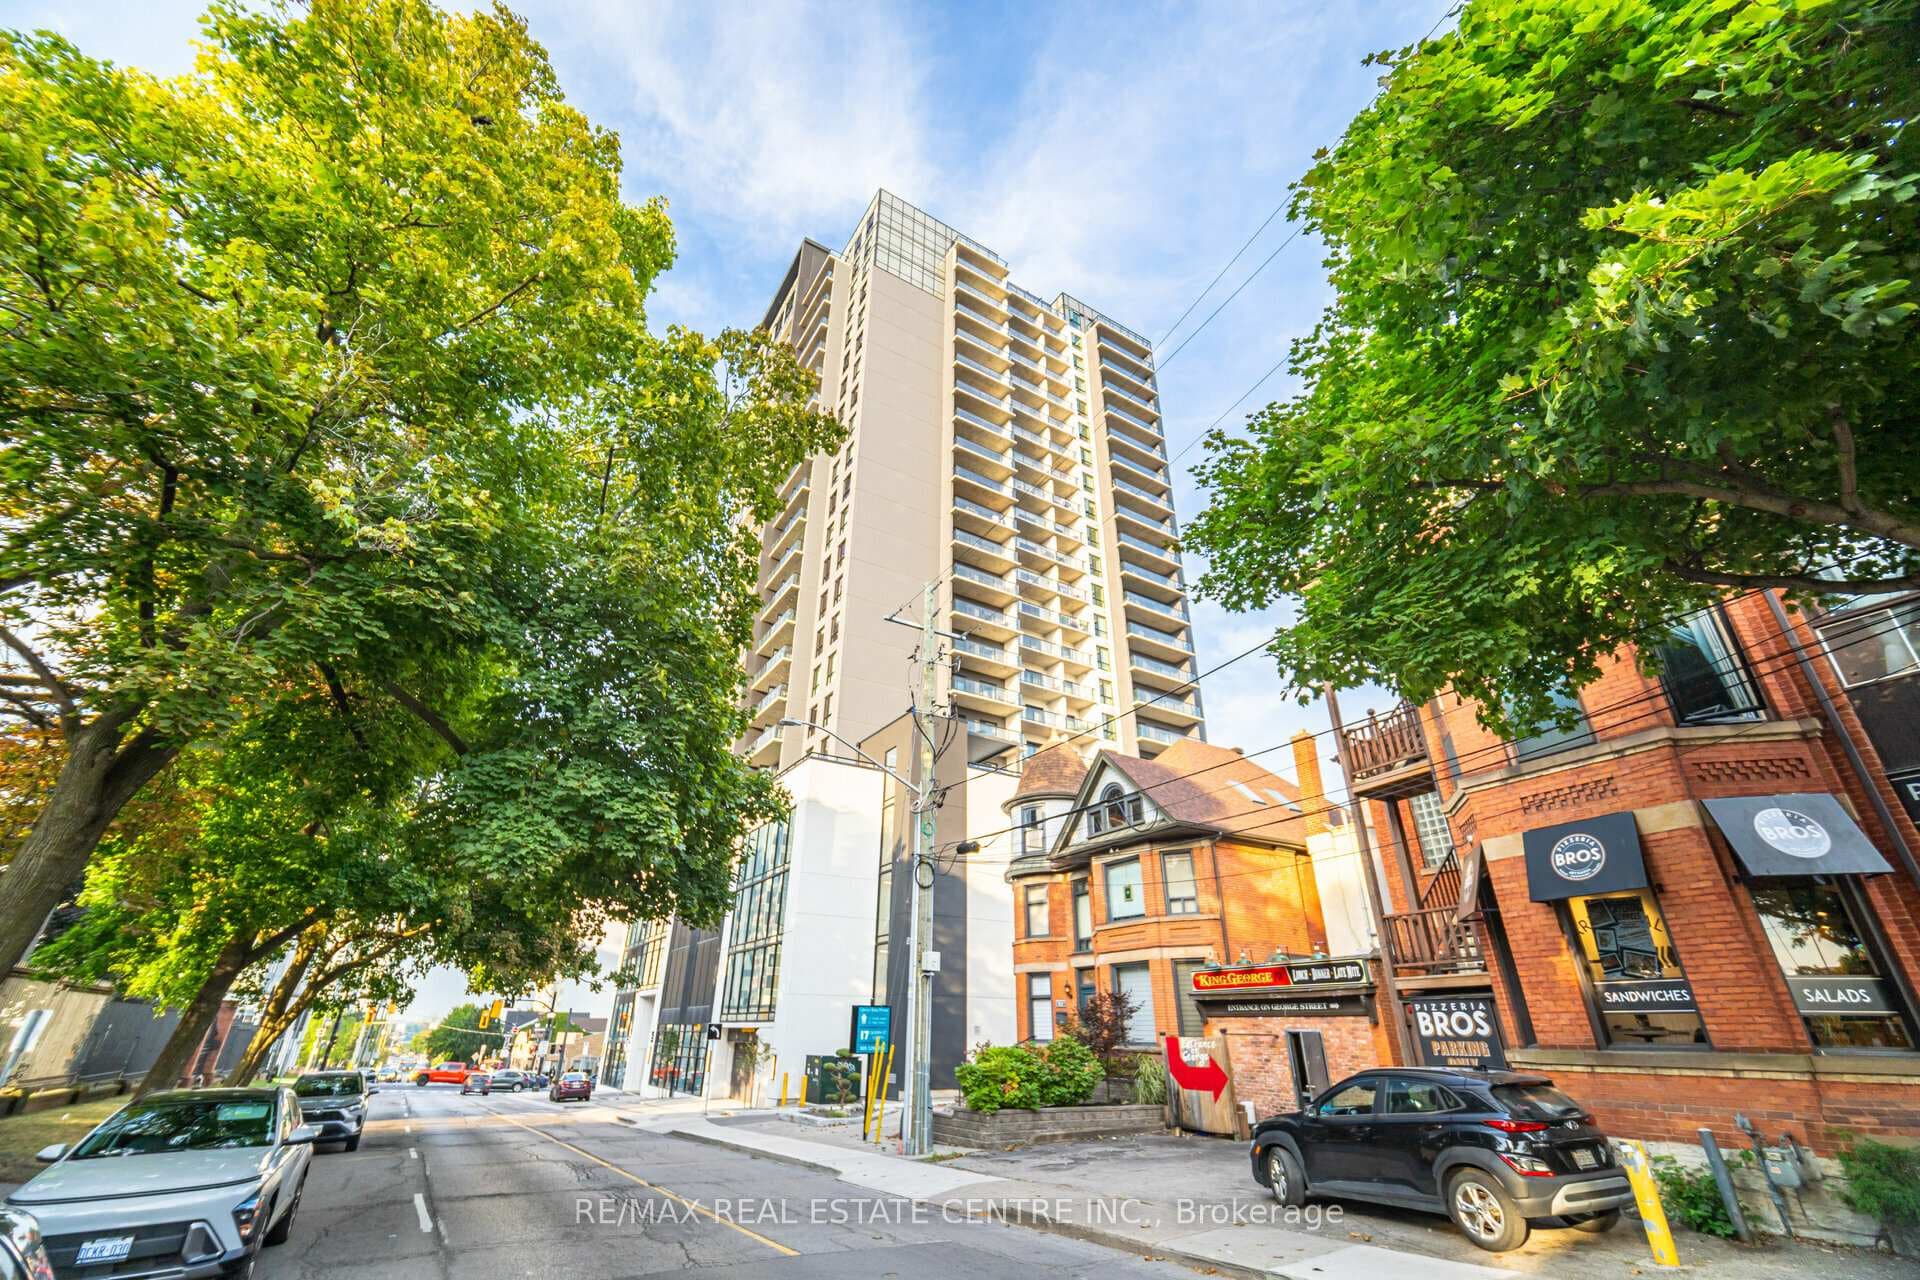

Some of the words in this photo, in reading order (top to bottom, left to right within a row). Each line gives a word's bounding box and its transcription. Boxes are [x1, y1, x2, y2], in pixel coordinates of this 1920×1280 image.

[1759, 824, 1821, 841] BROS
[1555, 847, 1601, 866] BROS
[1199, 974, 1227, 986] KING
[1227, 972, 1272, 985] GEORGE
[1604, 987, 1691, 1004] SANDWICHES
[1802, 988, 1872, 1003] SALADS
[1227, 1004, 1259, 1012] ENTRANCE
[1271, 1003, 1299, 1011] GEORGE
[1300, 1002, 1328, 1010] STREET
[1414, 1002, 1486, 1011] PIZZERIA
[1416, 1010, 1491, 1037] BROS
[1431, 1040, 1491, 1056] PARKING
